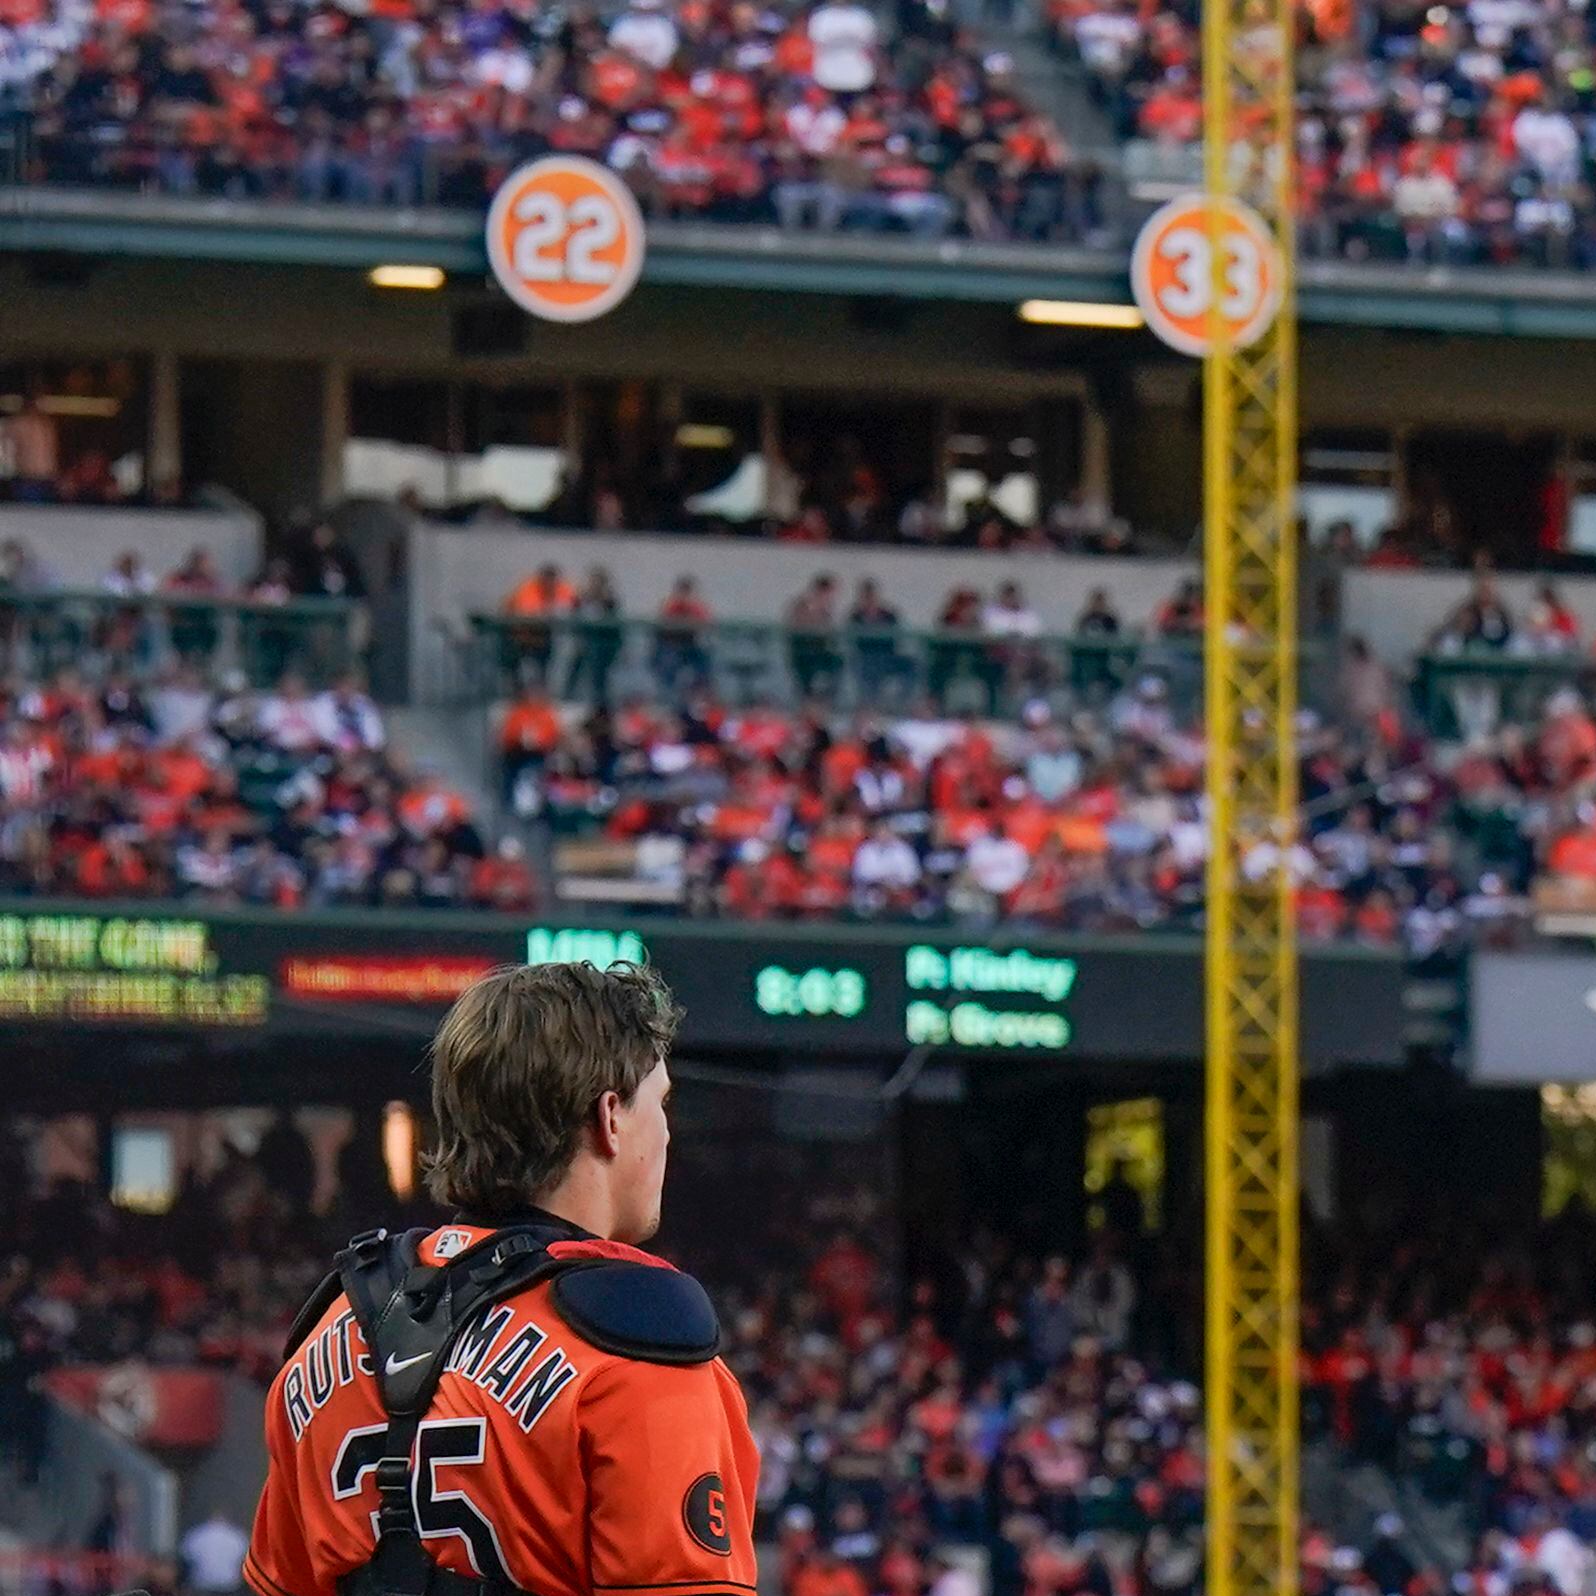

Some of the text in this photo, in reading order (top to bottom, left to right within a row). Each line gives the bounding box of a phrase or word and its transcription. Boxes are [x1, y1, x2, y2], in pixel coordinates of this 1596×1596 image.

[515, 190, 620, 281] 22
[1159, 227, 1260, 318] 33
[284, 1305, 578, 1442] RUTMAN
[708, 1489, 727, 1538] 5
